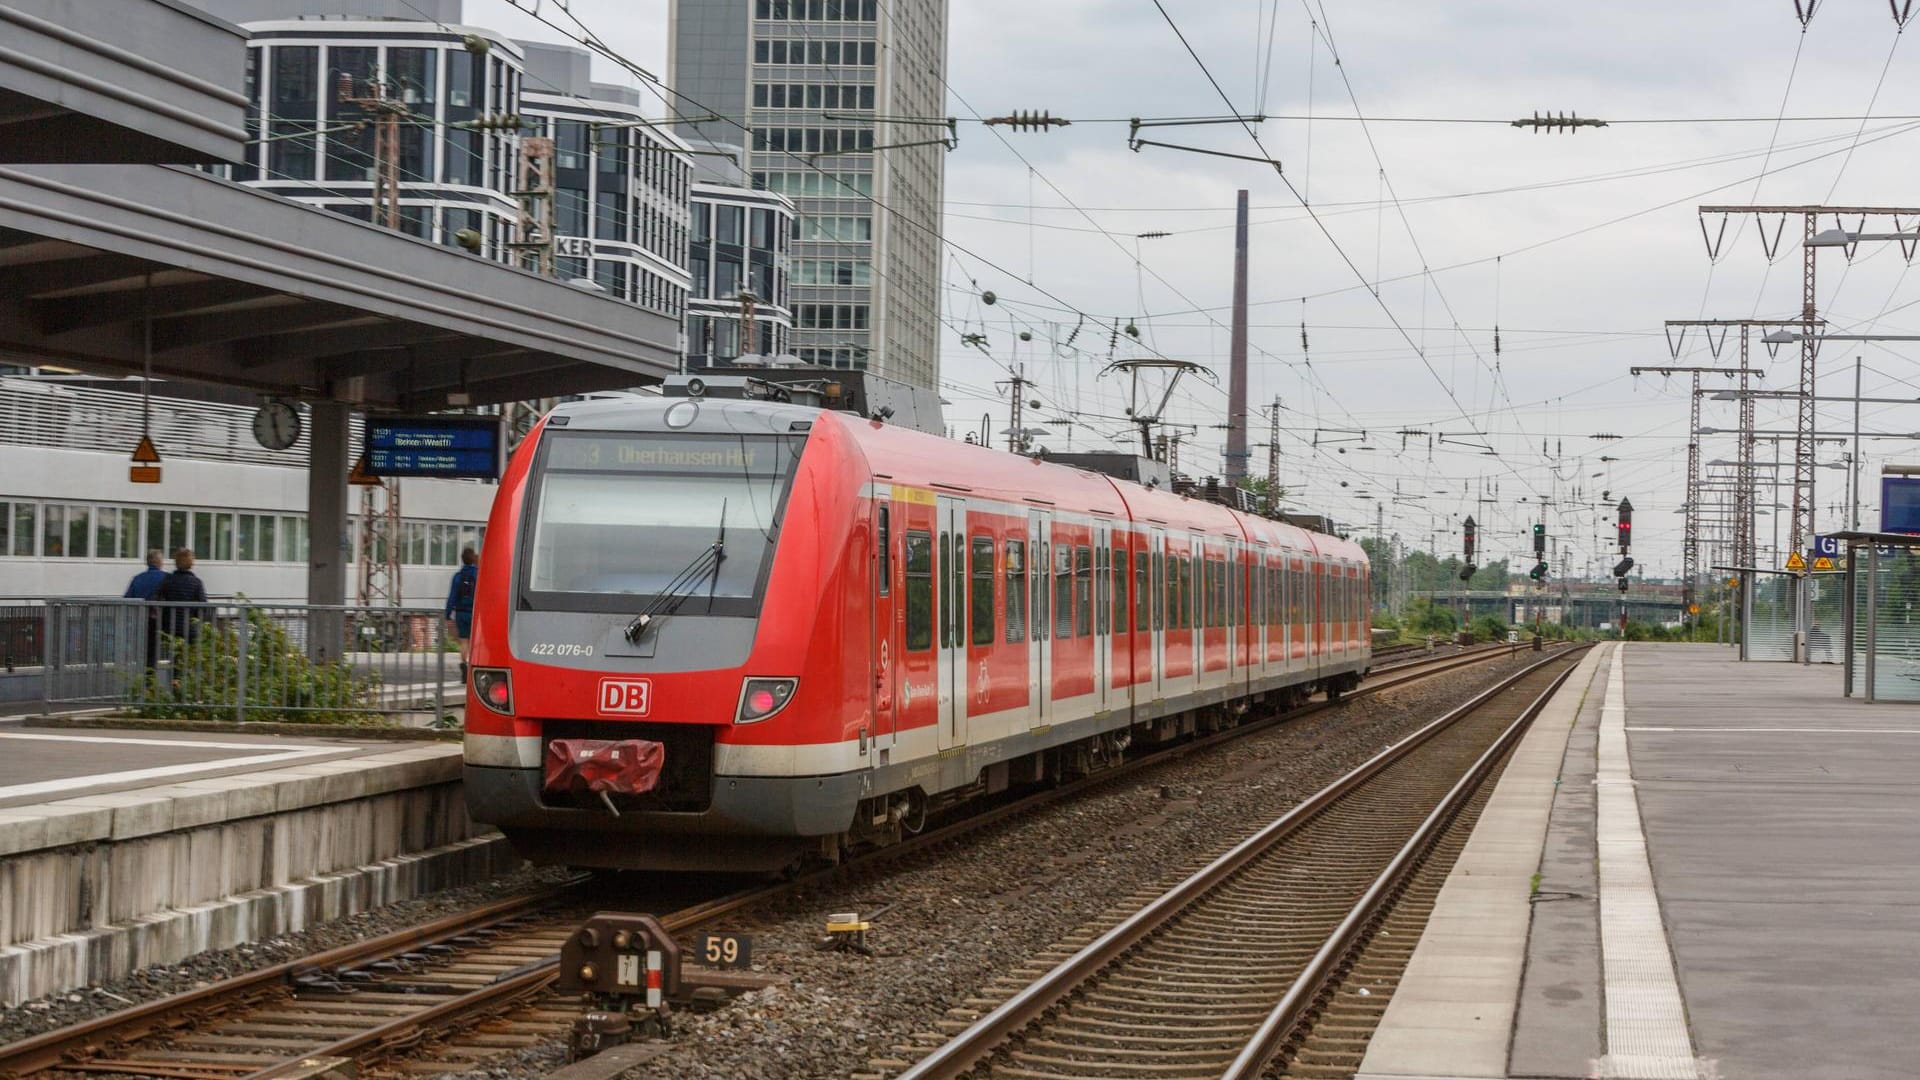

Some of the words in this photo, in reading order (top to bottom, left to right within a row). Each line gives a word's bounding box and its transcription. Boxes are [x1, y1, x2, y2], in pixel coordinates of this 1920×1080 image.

[618, 447, 723, 466] Oberhausen
[1821, 537, 1836, 554] G
[531, 643, 554, 656] 422
[557, 643, 594, 657] 076-0
[604, 683, 644, 710] DB
[705, 935, 739, 964] 59
